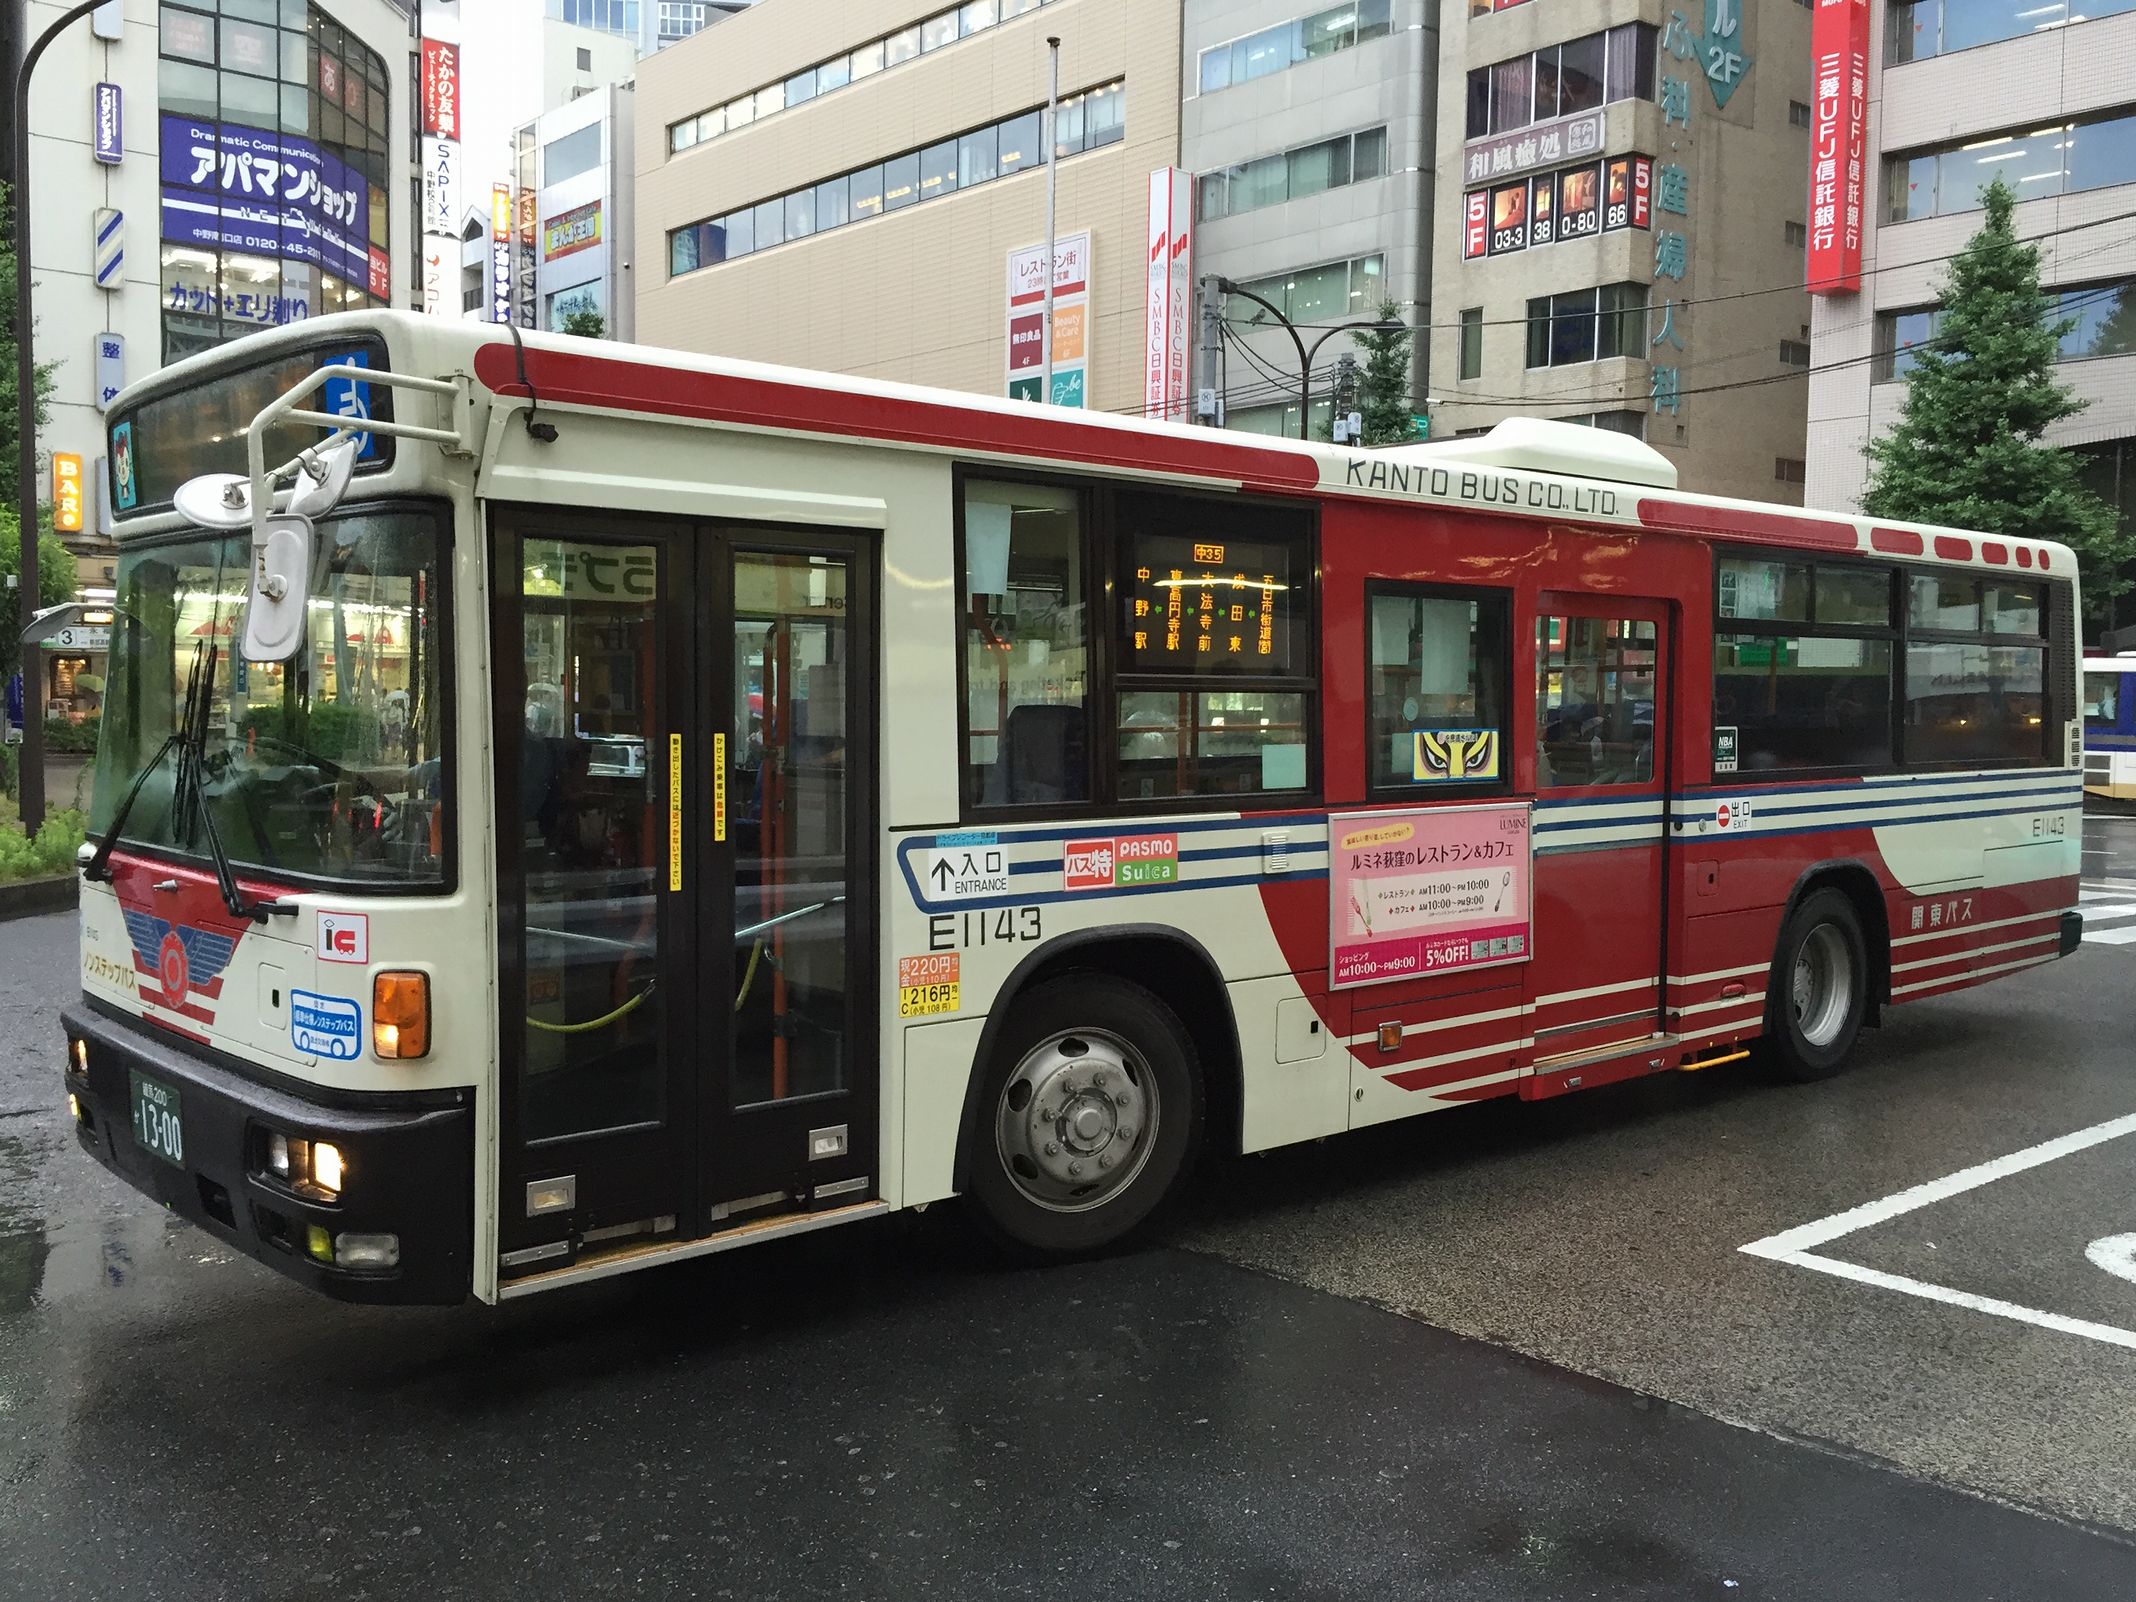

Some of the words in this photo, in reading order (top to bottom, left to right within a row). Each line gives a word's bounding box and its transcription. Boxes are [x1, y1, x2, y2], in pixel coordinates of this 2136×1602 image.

[1708, 46, 1741, 83] 2F
[438, 46, 455, 132] たかの友梨
[191, 129, 249, 148] Dramatic
[1813, 52, 1840, 250] 三菱UFJ信託銀行
[1846, 52, 1864, 250] 三菱UFJ信託銀行
[191, 147, 357, 226] アパマンショップ
[438, 144, 450, 217] SAPIX
[1635, 162, 1649, 220] 5F
[1469, 196, 1485, 253] 5F
[1012, 330, 1041, 345] 無印良品
[1151, 288, 1162, 416] SMBC日興証券
[1172, 287, 1183, 416] SMBC日興証券
[1346, 457, 1449, 496] KANTO
[1460, 473, 1519, 505] BUS
[1195, 546, 1222, 561] 中35
[1135, 567, 1150, 649] 中野駅
[1229, 573, 1246, 652] 成田東
[61, 630, 73, 645] 3
[1500, 818, 1527, 830] LUMINE
[1731, 802, 1749, 817] 出口
[1734, 819, 1747, 828] EXIT
[2033, 817, 2064, 837] E1143
[1119, 839, 1173, 857] PASMO
[1351, 841, 1514, 871] ルミネ荻窪のレストラン&カフェ
[961, 852, 1000, 876] 入口
[1067, 849, 1112, 878] バス特
[1122, 864, 1171, 881] Suica
[955, 878, 1007, 894] ENTRANCE
[1911, 898, 1972, 929] 関東バス
[929, 906, 1041, 951] E1143
[84, 951, 136, 990] ノンステップバス
[911, 956, 950, 975] 220円
[1339, 952, 1370, 964] ショッピング
[1426, 945, 1469, 967] 5%OFF!
[911, 985, 950, 1005] 216円
